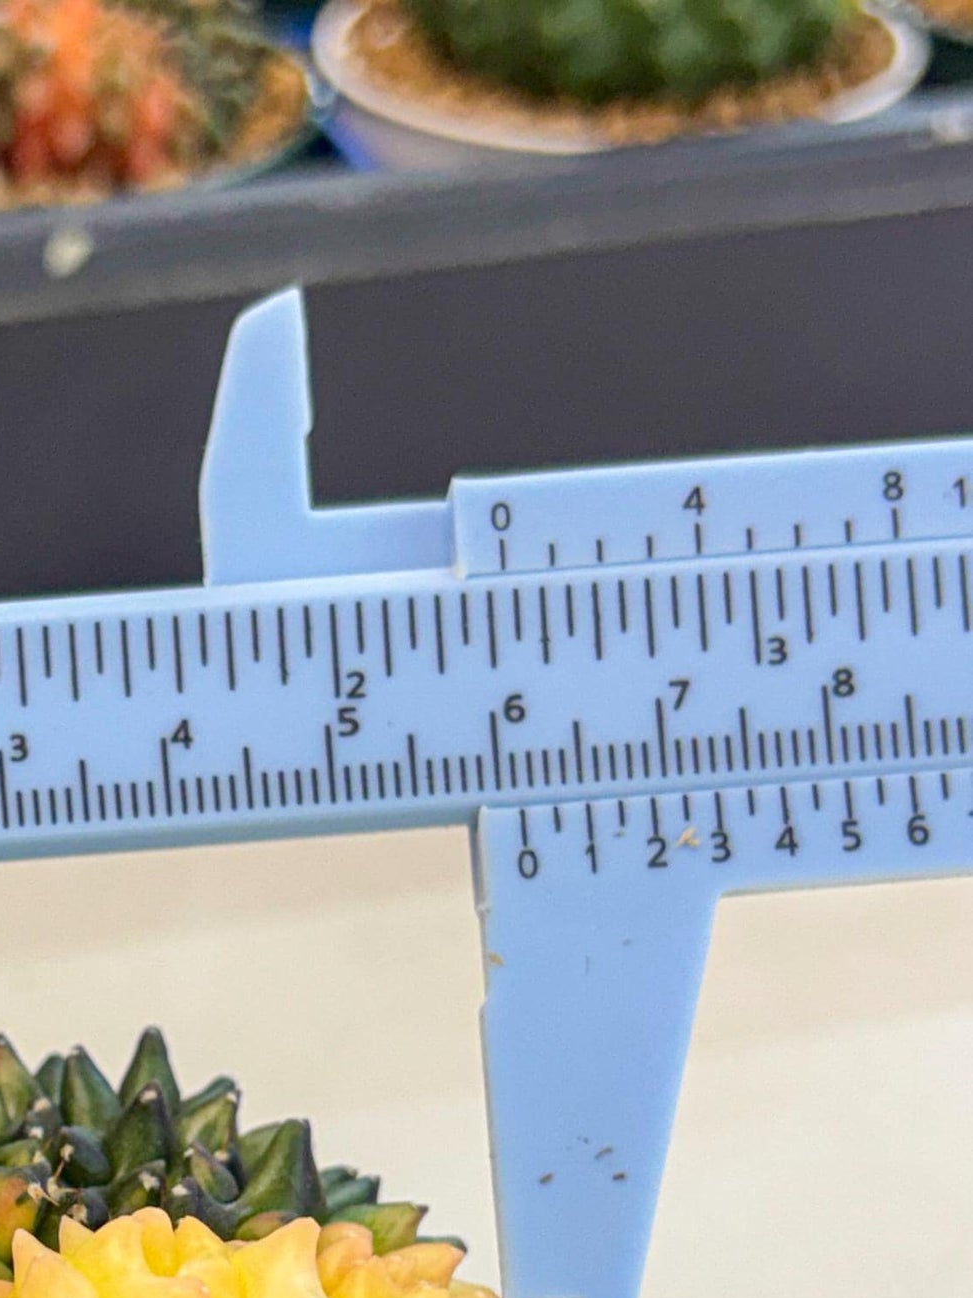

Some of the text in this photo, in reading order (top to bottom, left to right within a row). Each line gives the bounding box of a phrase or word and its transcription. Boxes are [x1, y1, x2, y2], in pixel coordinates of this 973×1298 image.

[490, 502, 512, 531] 0
[682, 486, 707, 515] 4
[882, 471, 905, 501] 8
[345, 672, 367, 699] 2
[767, 638, 787, 665] 3
[9, 734, 29, 762] 3
[170, 719, 193, 749] 4
[337, 707, 360, 736] 5
[503, 694, 526, 723] 6
[670, 679, 691, 710] 7
[831, 669, 855, 697] 8
[517, 815, 930, 879] 0 1 2 3 4 5 6
